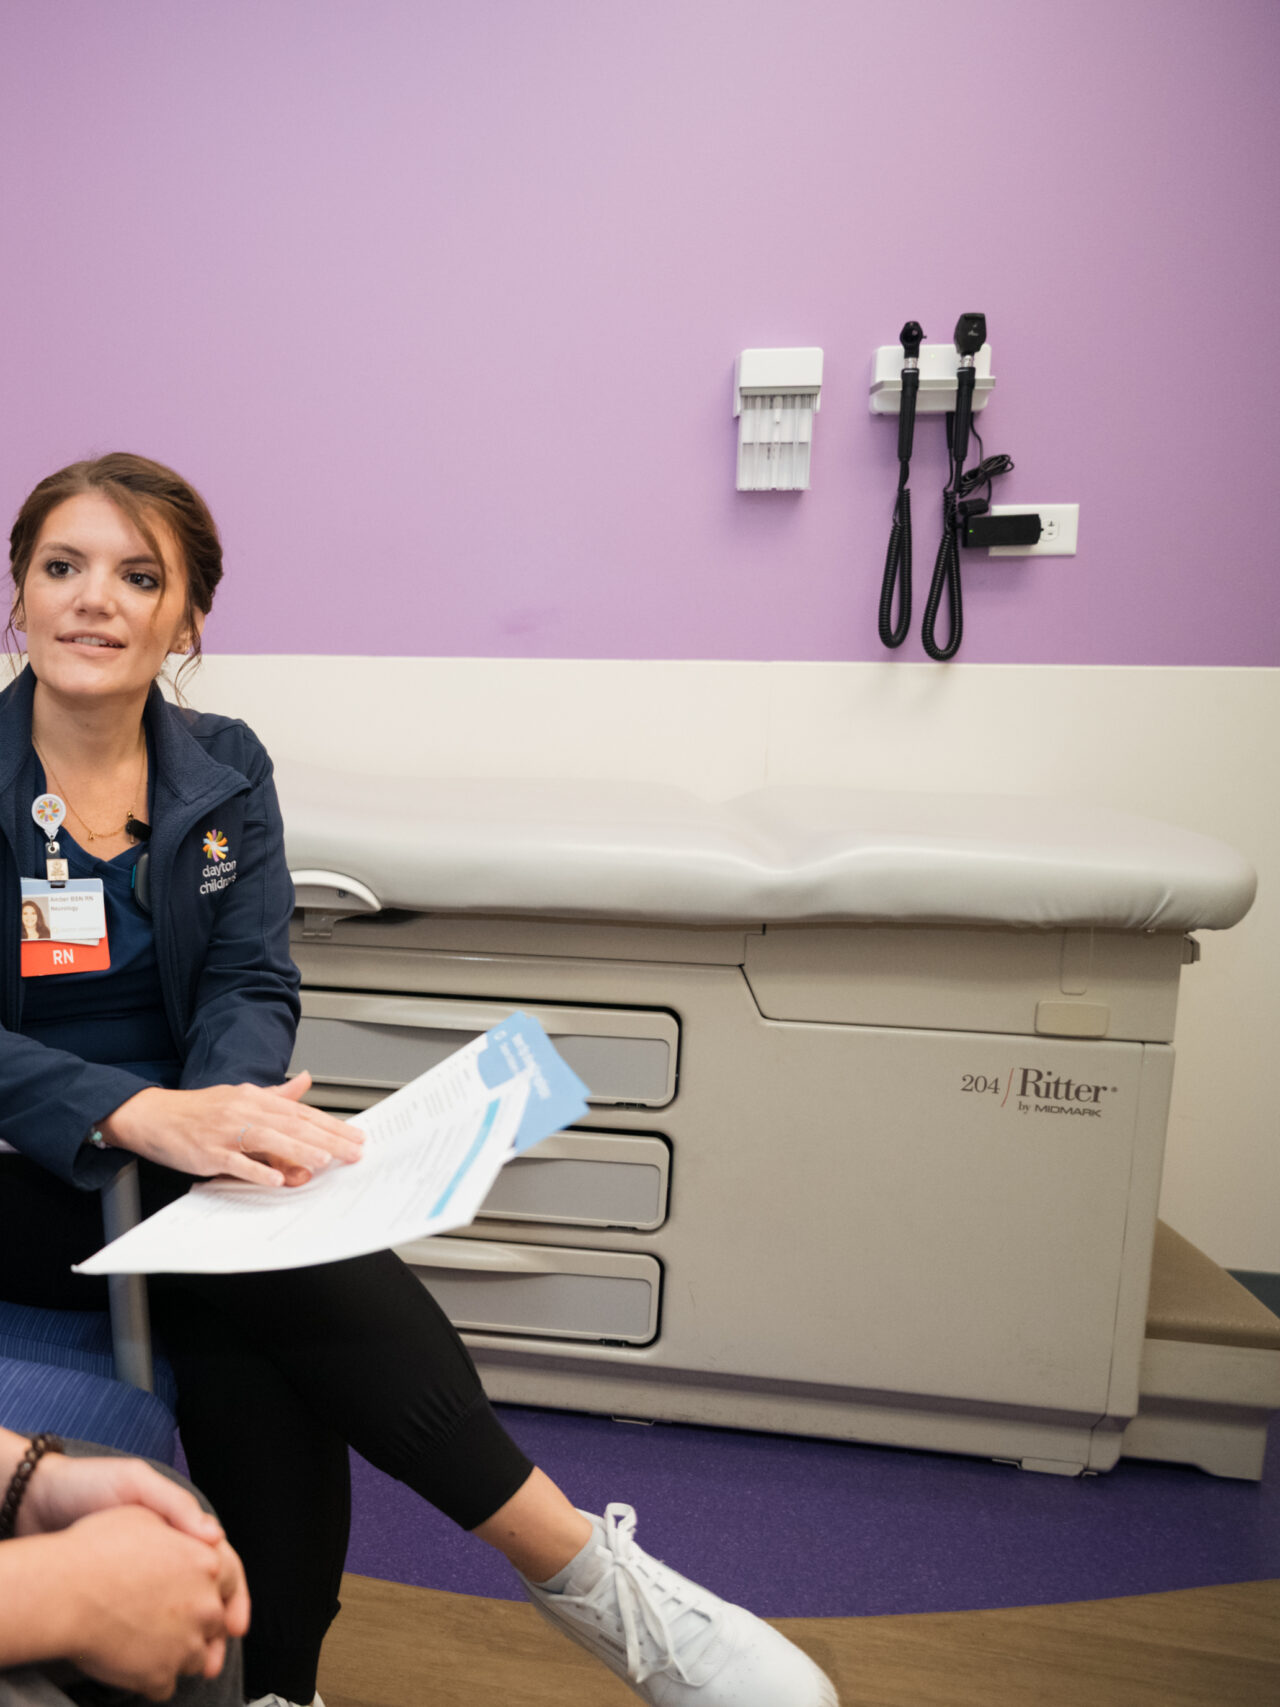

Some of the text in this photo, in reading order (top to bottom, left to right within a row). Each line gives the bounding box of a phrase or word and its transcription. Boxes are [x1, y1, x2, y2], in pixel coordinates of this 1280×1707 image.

[202, 860, 237, 878] dayton
[52, 949, 74, 965] RN
[960, 1073, 1001, 1095] 204
[1018, 1101, 1103, 1118] by MIDMARK
